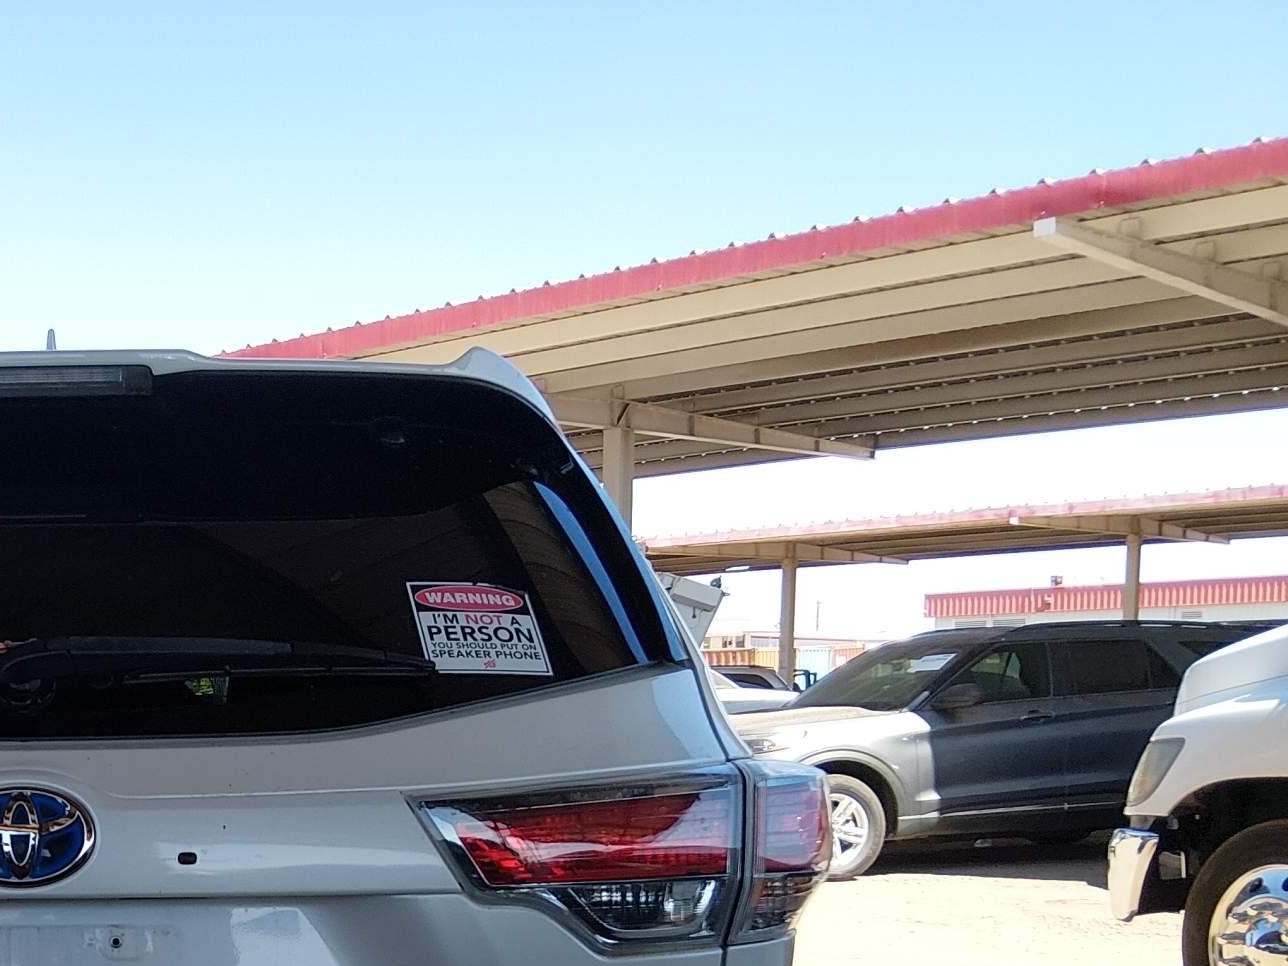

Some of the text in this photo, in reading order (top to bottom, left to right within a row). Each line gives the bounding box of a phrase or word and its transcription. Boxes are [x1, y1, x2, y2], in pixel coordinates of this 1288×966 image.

[425, 592, 515, 606] WARNING
[433, 613, 522, 626] I'M NOT A
[427, 625, 535, 644] PERSON
[456, 642, 498, 650] SHOULD
[501, 643, 519, 651] PUT
[431, 650, 542, 660] SPEAKER PHONE
